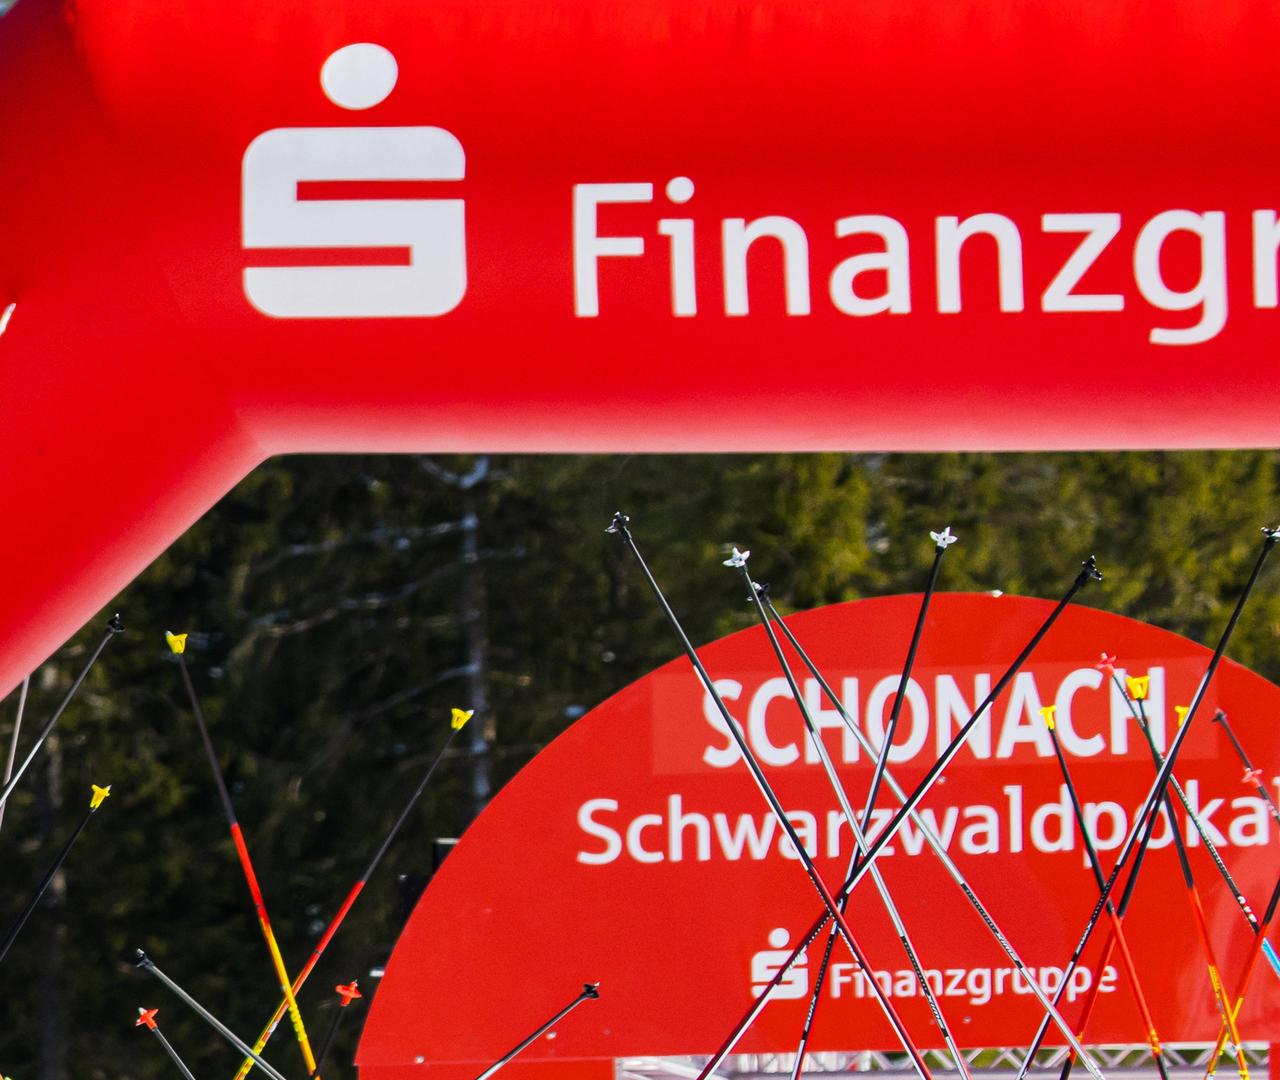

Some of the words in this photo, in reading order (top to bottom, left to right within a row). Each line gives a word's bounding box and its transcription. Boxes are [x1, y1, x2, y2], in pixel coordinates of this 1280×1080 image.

[703, 666, 1167, 767] SCHONACH
[577, 779, 1280, 869] Schwarzwaldpoka
[831, 962, 1117, 1006] Finanzgruppe
